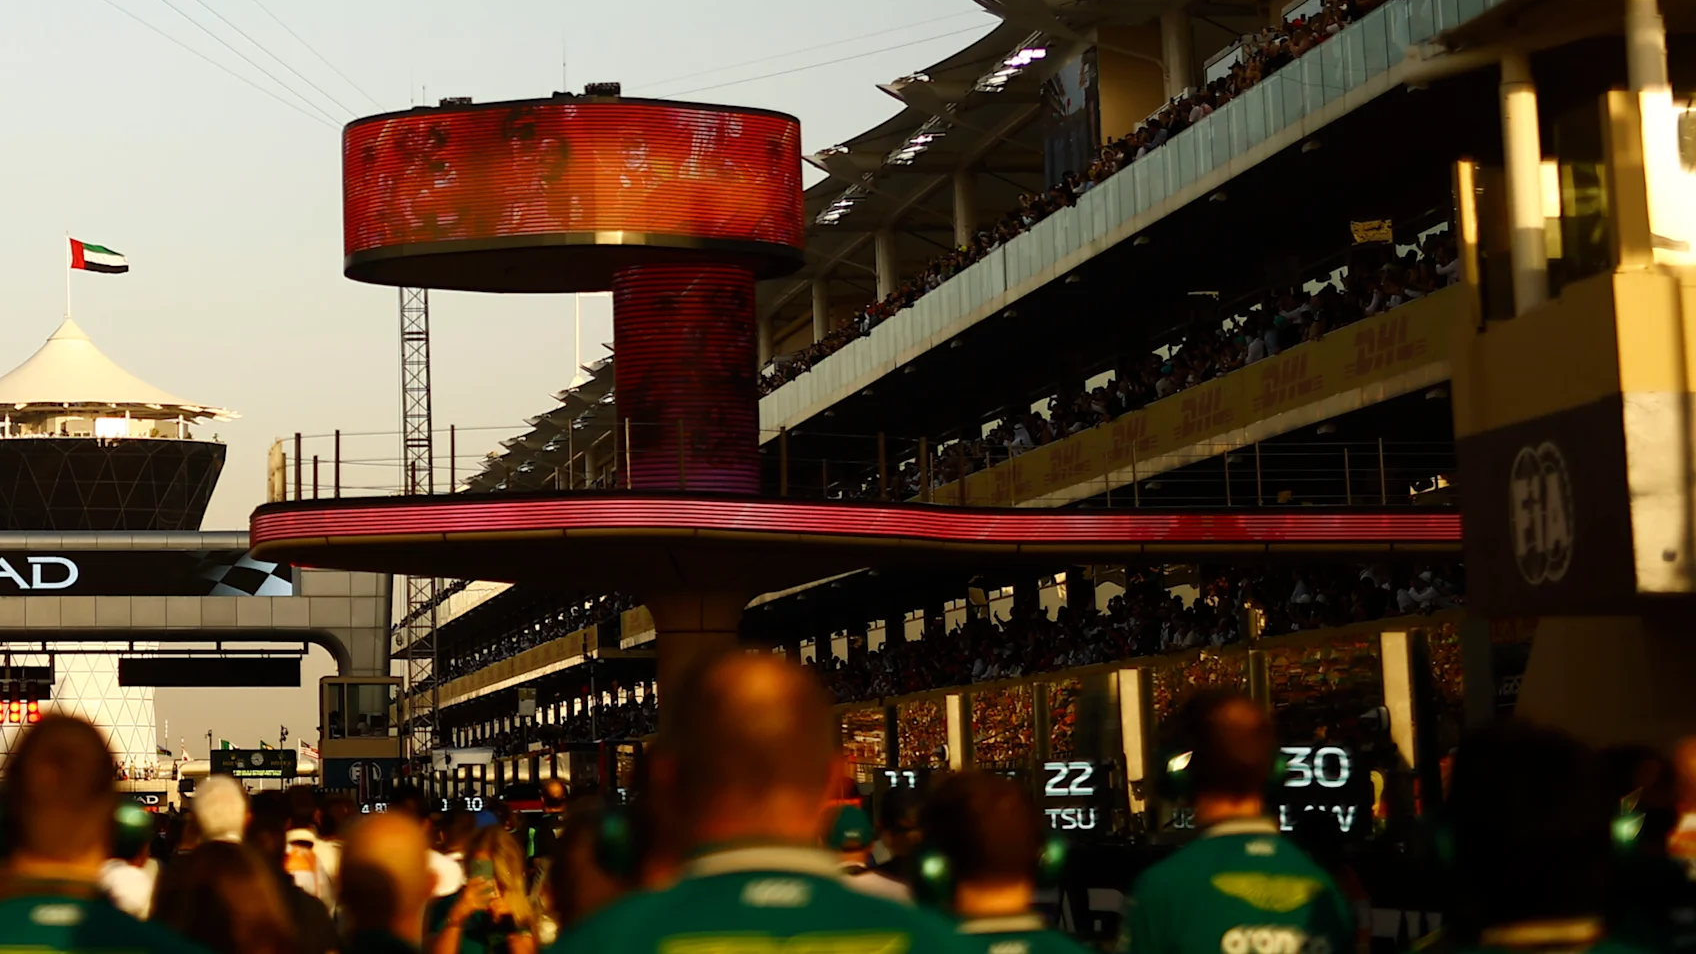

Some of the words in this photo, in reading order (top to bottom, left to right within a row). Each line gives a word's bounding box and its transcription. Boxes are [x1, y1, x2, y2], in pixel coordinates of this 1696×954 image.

[1354, 314, 1416, 377] DHL
[1261, 353, 1314, 408] DHL
[1182, 387, 1227, 436] DHL
[1043, 761, 1096, 796] 22
[1279, 746, 1352, 788] 30
[464, 797, 483, 812] 10
[1044, 808, 1097, 830] TSU
